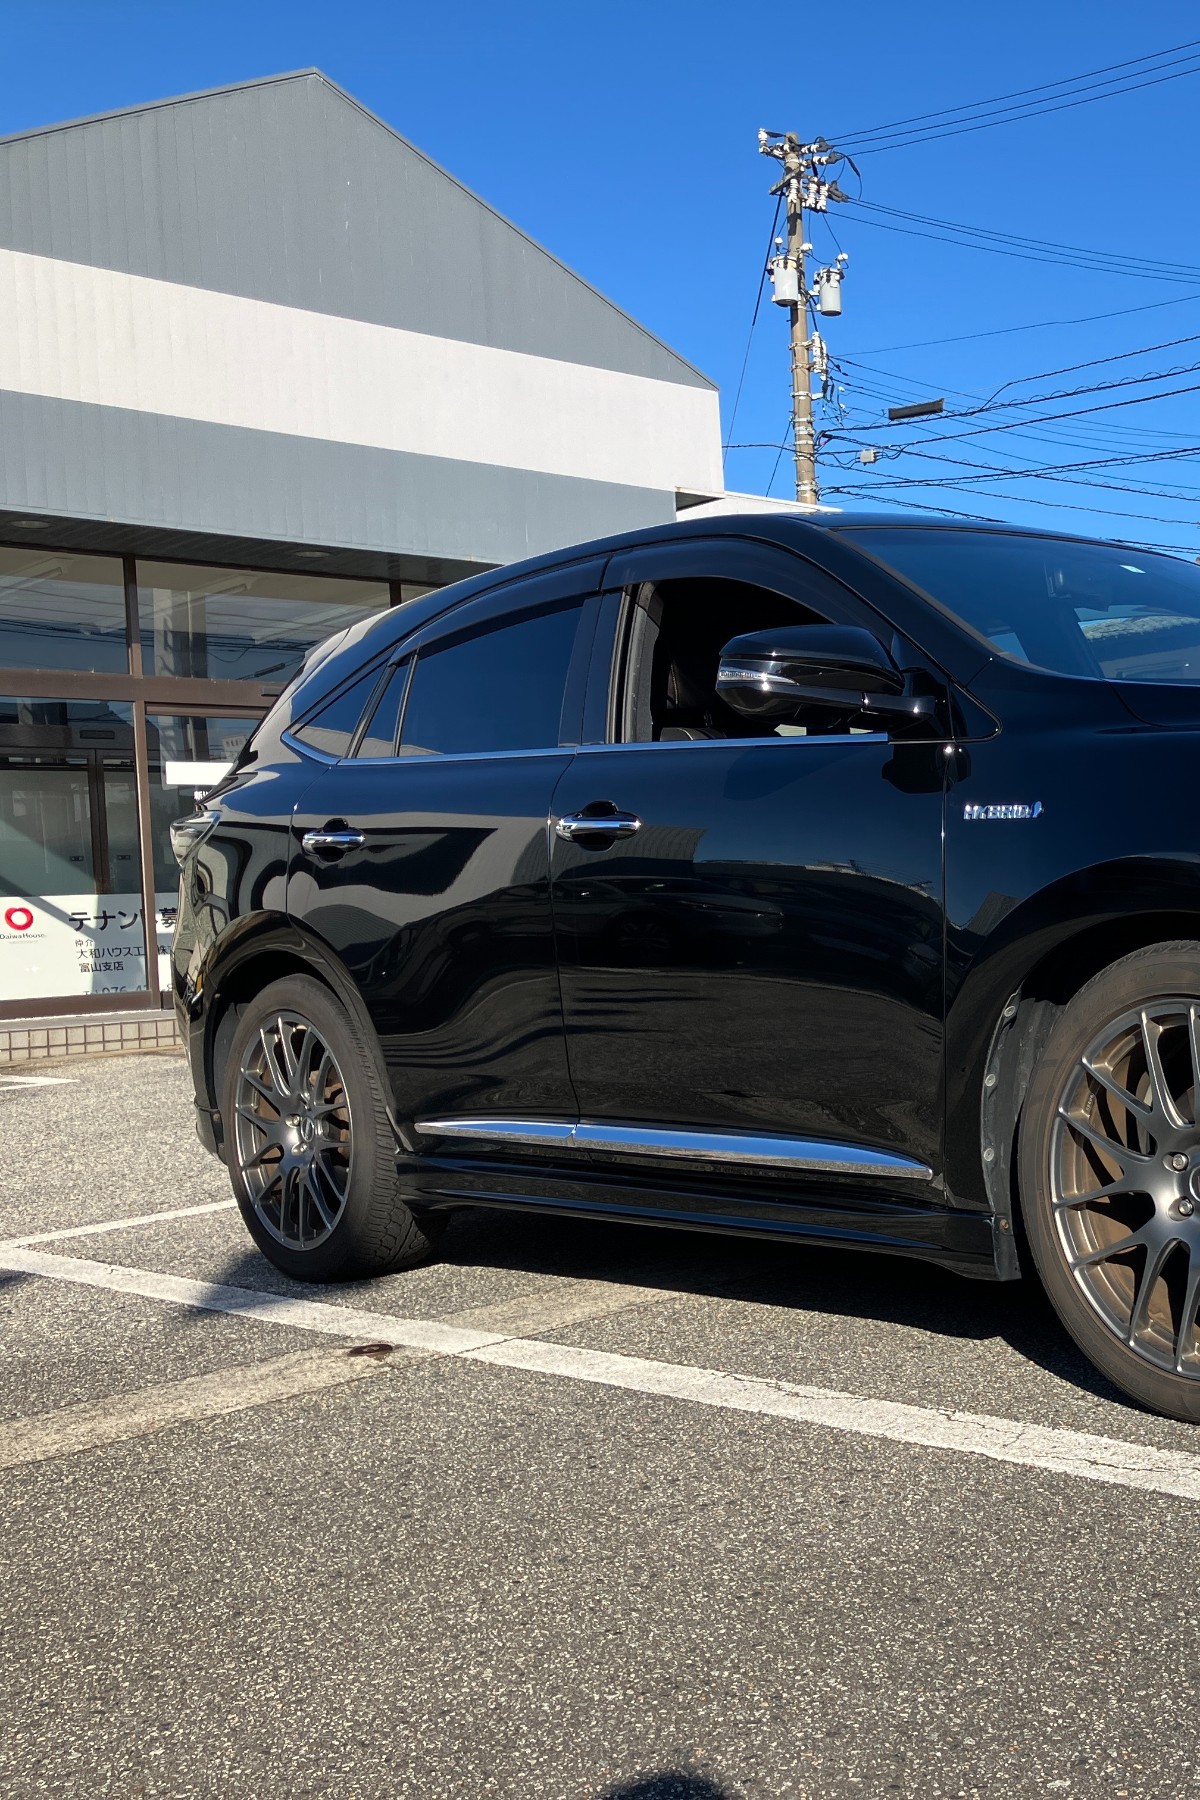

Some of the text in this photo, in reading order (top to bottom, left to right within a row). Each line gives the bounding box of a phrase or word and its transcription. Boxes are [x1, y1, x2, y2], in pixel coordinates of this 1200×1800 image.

[963, 804, 1031, 820] HYBRID
[79, 962, 124, 973] 富山支店
